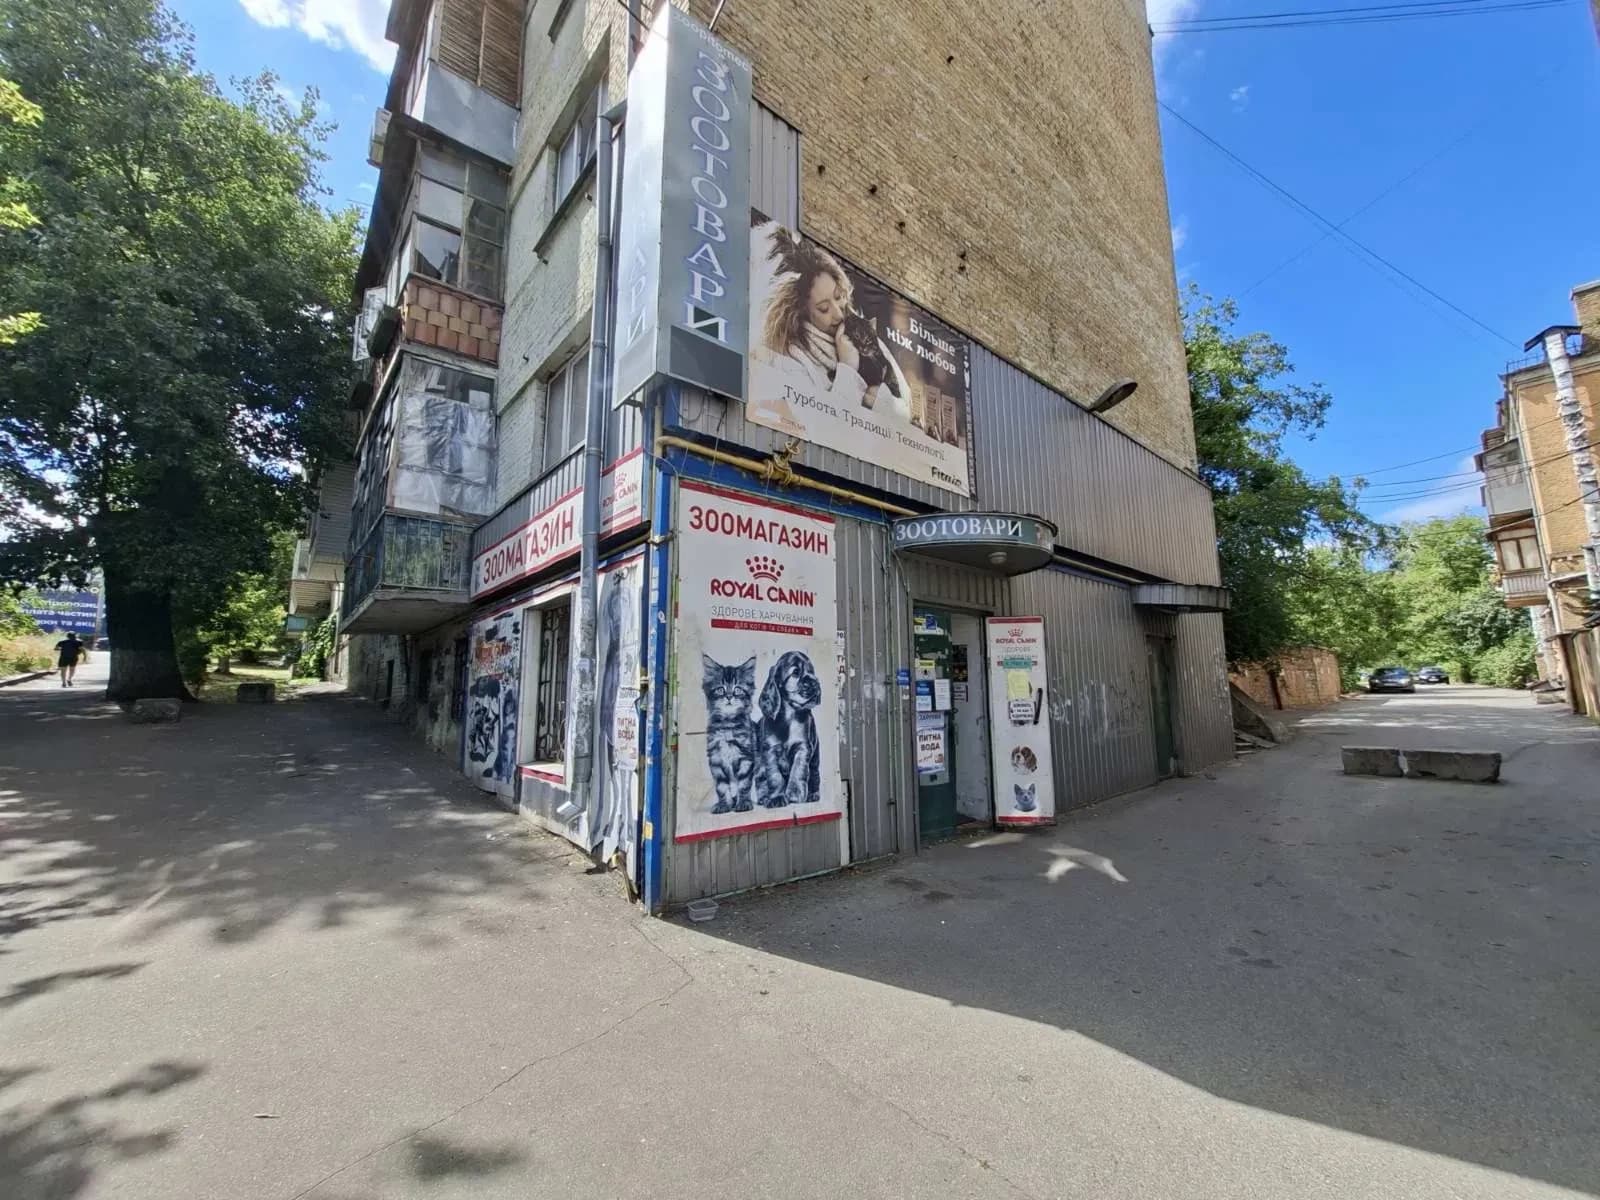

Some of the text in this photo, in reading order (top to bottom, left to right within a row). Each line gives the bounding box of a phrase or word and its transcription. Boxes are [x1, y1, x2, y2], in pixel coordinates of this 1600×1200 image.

[684, 50, 731, 343] ЗООТОВАРИ
[886, 326, 956, 375] ніж любов
[909, 317, 956, 356] Більше
[483, 505, 575, 585] ЗООМАГАЗИН
[688, 505, 829, 556] ЗООМАГАЗИН
[896, 517, 1023, 541] ЗООТОВАРИ
[710, 578, 815, 608] ROYAL CANIN
[711, 605, 814, 625] ЗДОРОВЕ ХАРЧУВАННЯ
[918, 732, 941, 742] ПИТНА
[920, 742, 940, 751] ВОДА
